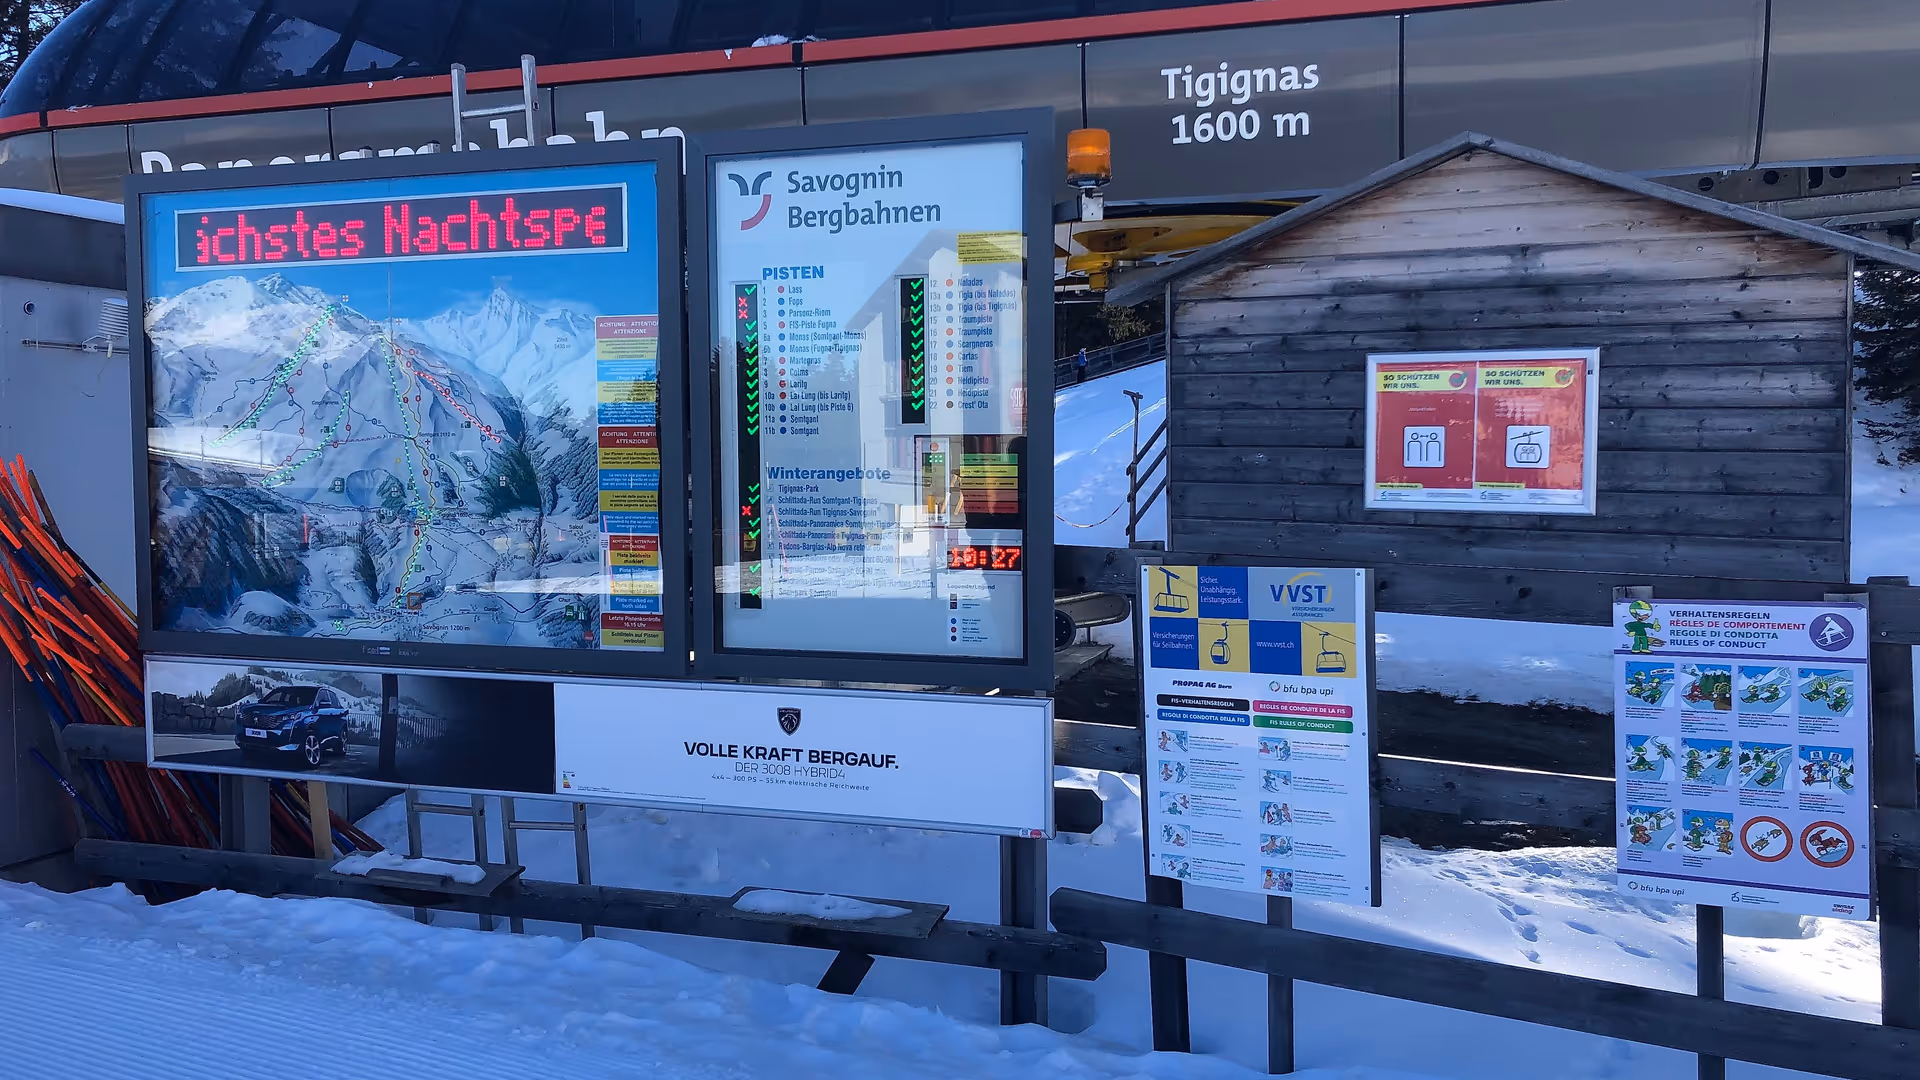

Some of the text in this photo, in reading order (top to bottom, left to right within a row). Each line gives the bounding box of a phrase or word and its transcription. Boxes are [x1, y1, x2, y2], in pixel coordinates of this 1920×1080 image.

[1160, 61, 1320, 107] Tigignas
[1171, 109, 1310, 145] 1600 m
[787, 165, 903, 199] Savognin
[788, 200, 941, 234] Bergbahnen
[762, 265, 824, 280] PISTEN
[930, 280, 938, 288] 12
[788, 286, 803, 294] Lass
[958, 327, 993, 338] Traumpiste
[958, 352, 978, 361] Cartas
[1397, 372, 1440, 381] SCHÜTZEN
[1499, 368, 1545, 377] SCHÜTZEN
[958, 376, 989, 386] Heidipiste
[764, 392, 775, 400] 10a
[790, 392, 800, 400] Lai
[801, 392, 816, 401] Lung
[818, 391, 829, 401] (bis
[764, 403, 776, 412] 10b
[790, 403, 800, 412] Lai
[801, 403, 816, 413] Lung
[818, 402, 830, 412] (bis
[830, 404, 846, 412] Piste
[978, 400, 989, 409] Ota
[764, 415, 776, 424] 11a
[765, 426, 776, 435] 11b
[767, 466, 891, 482] Winterangebote
[778, 484, 820, 494] Tigignas-Park
[950, 547, 1021, 569] 10:27
[1269, 584, 1327, 604] VVST
[1200, 596, 1244, 605] Leistungsstark.
[1669, 610, 1770, 620] VERHALTENSREGELN
[422, 624, 449, 632] Savognin
[1707, 620, 1720, 629] DE
[1723, 621, 1806, 630] COMPORTEMENT
[1152, 632, 1195, 642] Versicherungen
[1670, 629, 1779, 640] REGOLE DI CONDOTTA
[1152, 641, 1161, 649] für
[1670, 638, 1767, 649] RULES OF CONDUCT
[1172, 680, 1204, 688] PROPAG
[1283, 684, 1334, 697] bfu bpa upi
[1190, 714, 1220, 722] CONDOTTA
[1306, 722, 1335, 730] CONDUCT
[684, 741, 900, 770] VOLLE KRAFT BERGAUF.
[734, 762, 846, 780] DER 3008 HYBRID4
[776, 778, 787, 786] km
[788, 779, 828, 788] elektrische
[830, 782, 870, 792] Reichweite
[1656, 886, 1670, 894] bpa
[1672, 888, 1685, 896] upi
